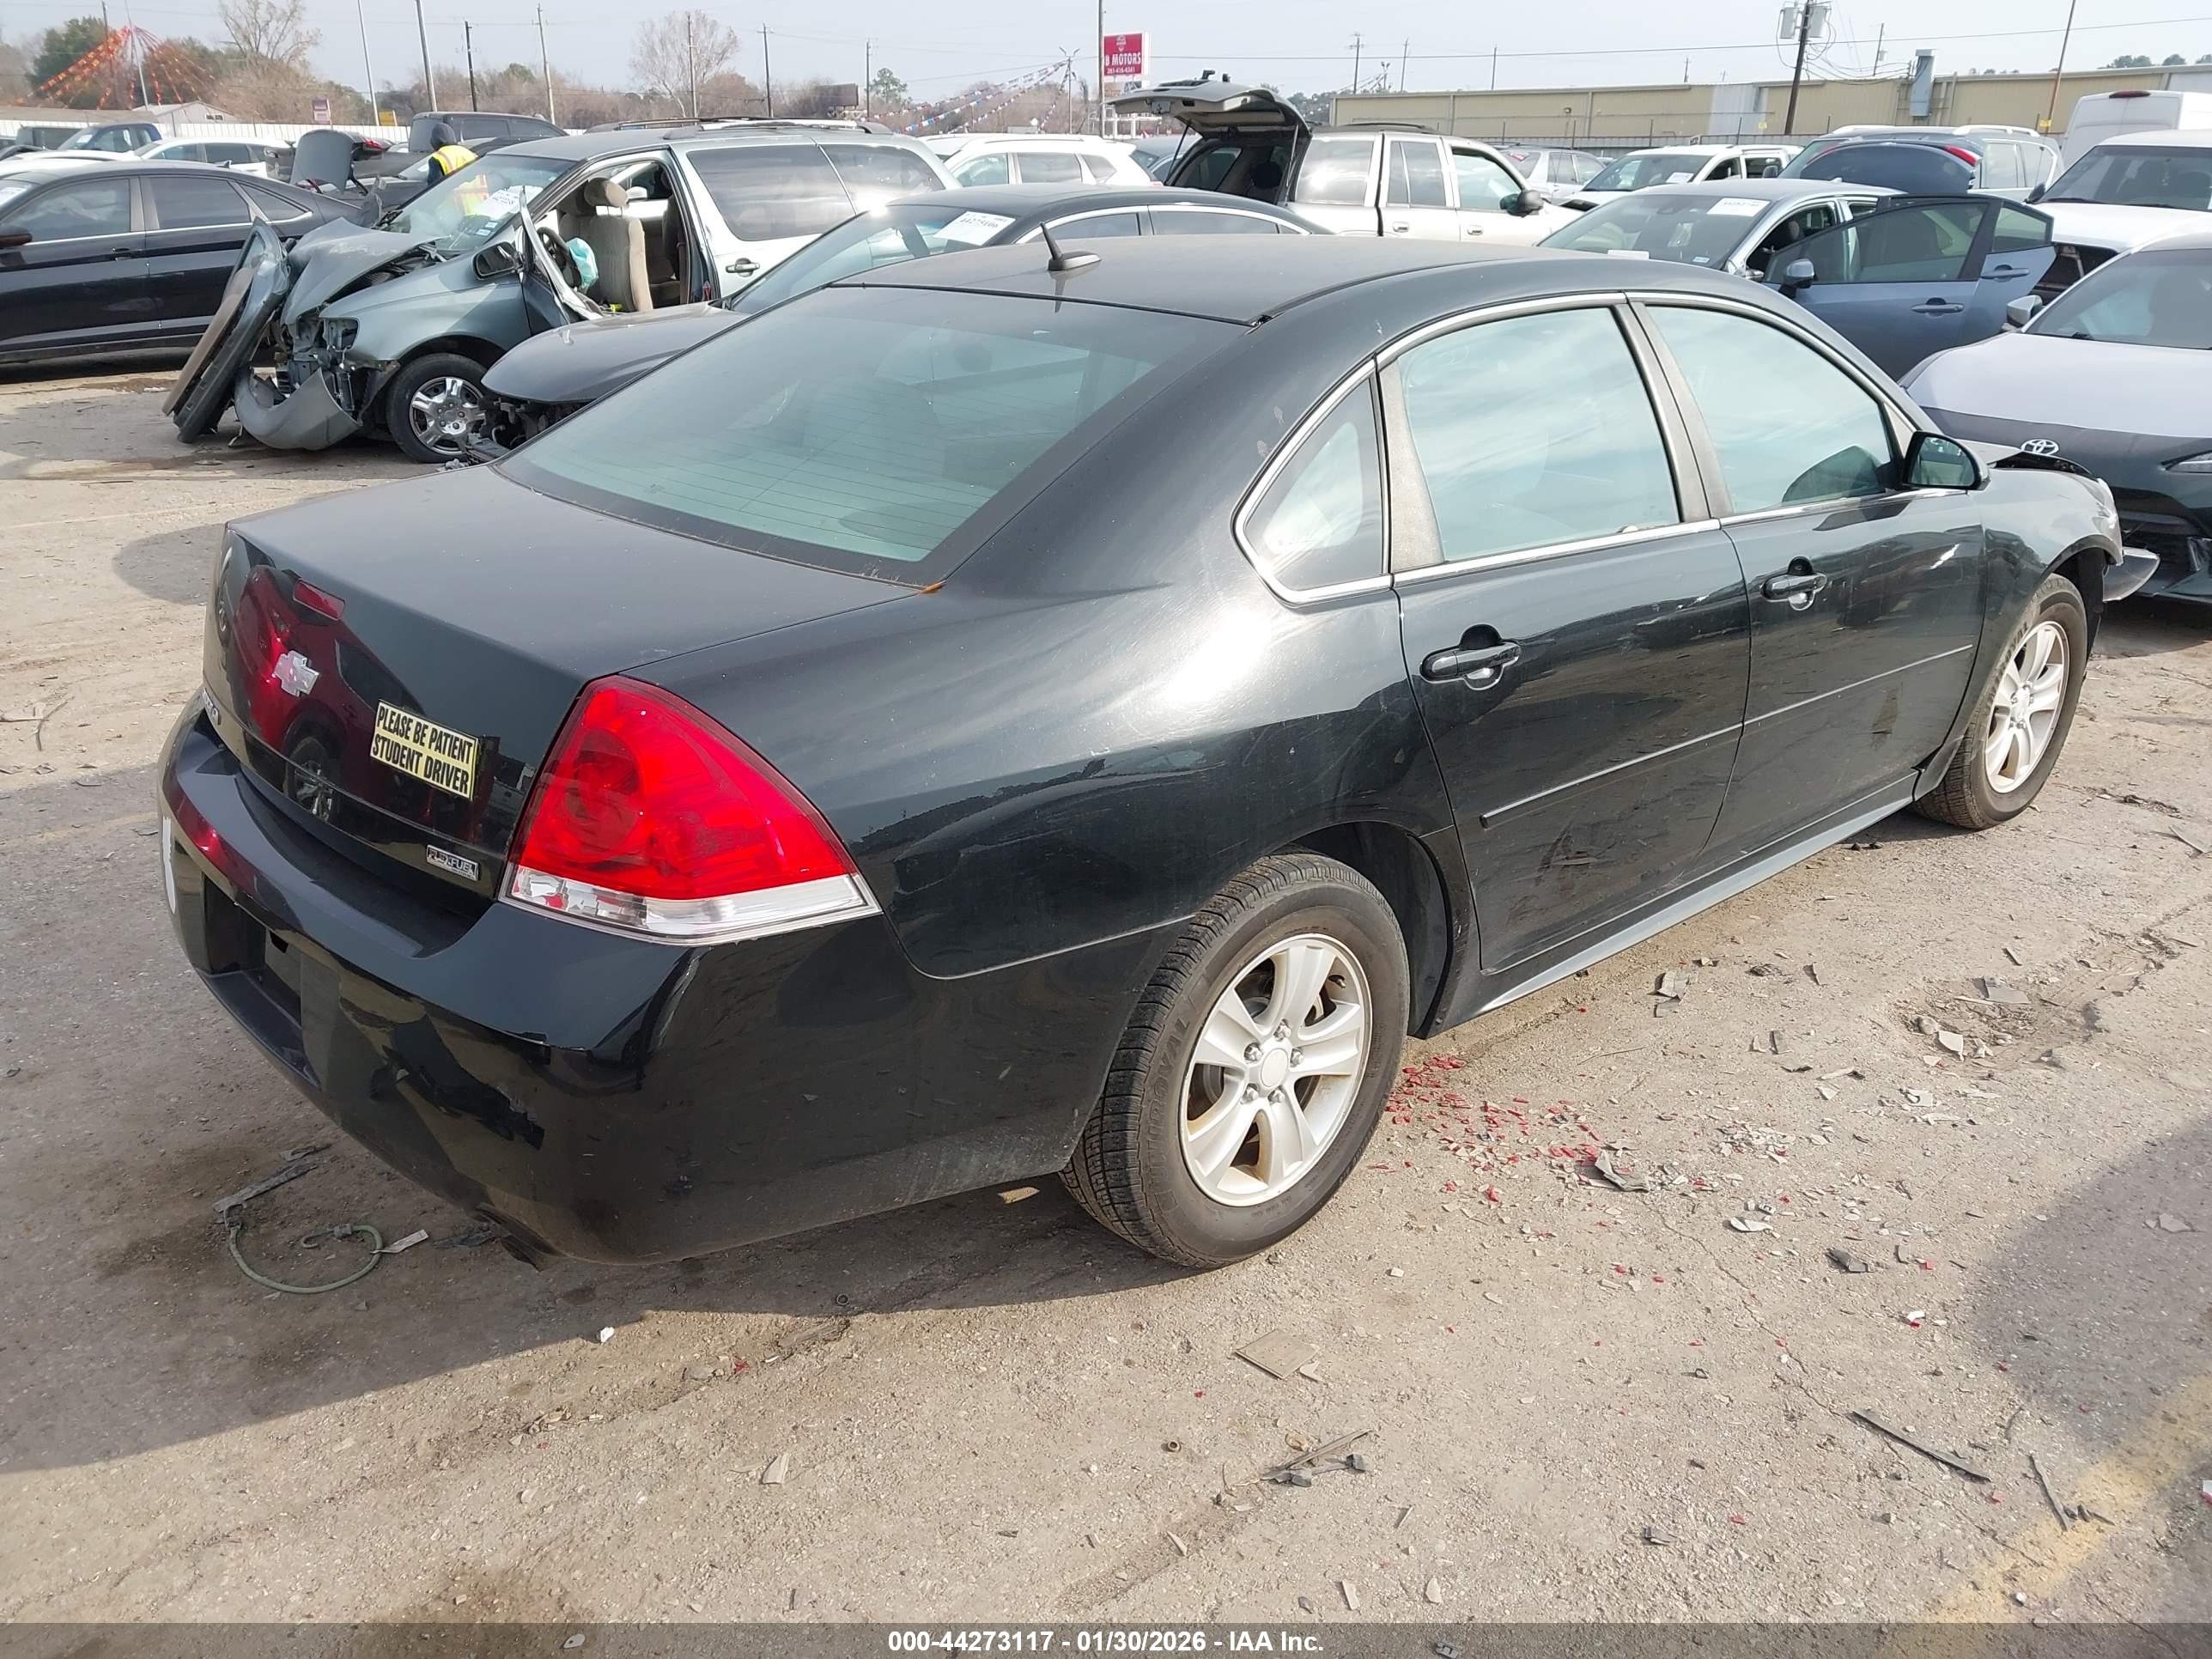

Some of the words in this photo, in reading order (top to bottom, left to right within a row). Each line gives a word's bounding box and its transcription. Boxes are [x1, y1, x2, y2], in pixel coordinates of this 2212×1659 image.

[1112, 52, 1141, 65] MOTORS
[373, 733, 423, 775] STUDENT
[423, 756, 470, 794] DRIVER
[376, 705, 413, 740] PLEASE
[412, 721, 429, 747] BE
[428, 727, 473, 764] PATIENT
